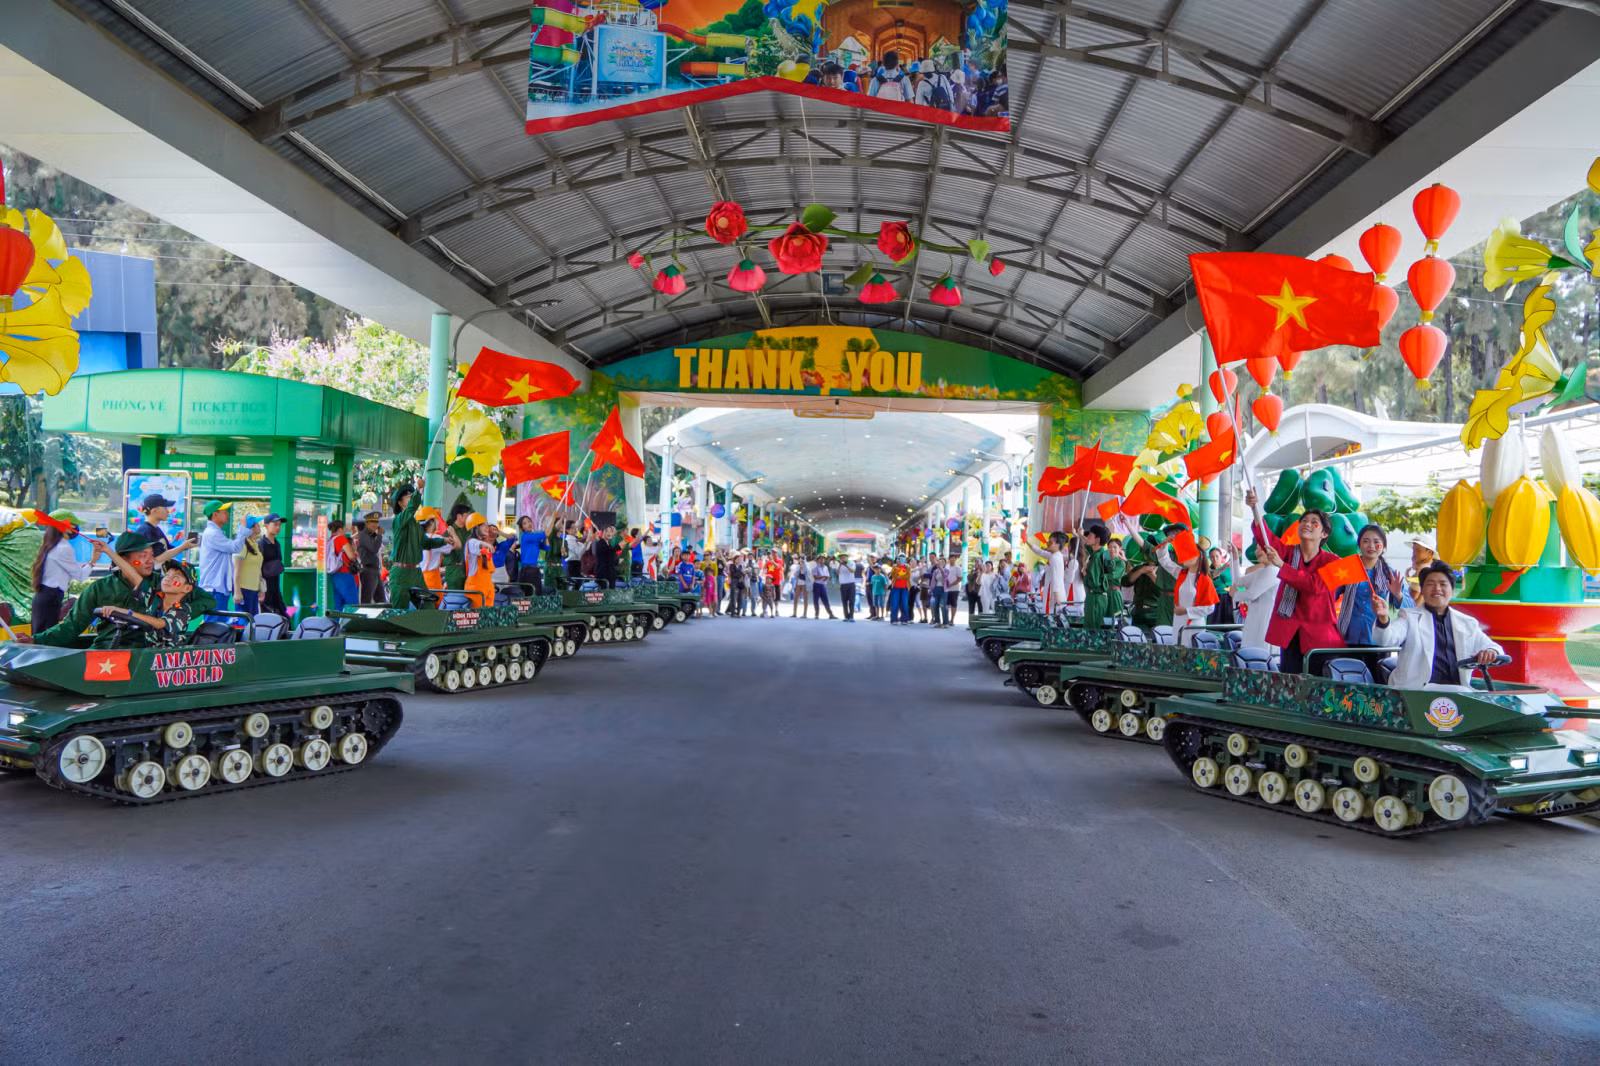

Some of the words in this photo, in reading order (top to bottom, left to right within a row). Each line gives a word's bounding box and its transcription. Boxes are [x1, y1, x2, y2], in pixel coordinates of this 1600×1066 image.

[674, 348, 805, 391] THANK
[846, 351, 922, 393] YOU
[191, 401, 239, 412] TICKET
[241, 401, 267, 412] BOX
[151, 648, 236, 671] AMAZING
[156, 666, 223, 688] WORLD
